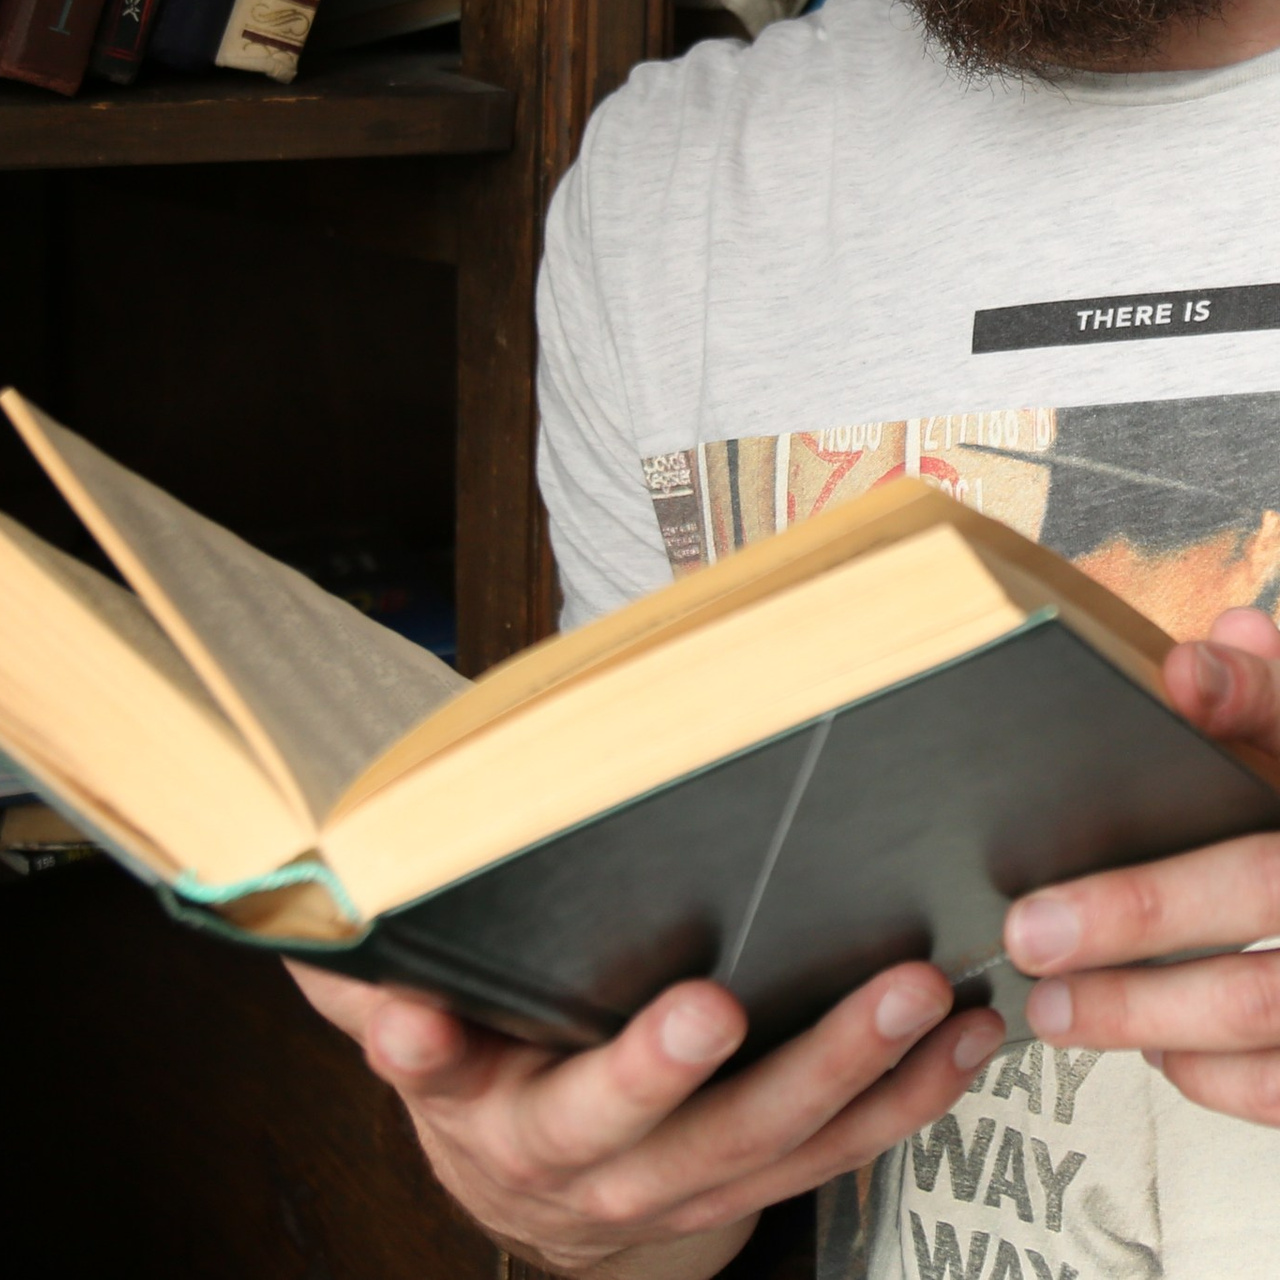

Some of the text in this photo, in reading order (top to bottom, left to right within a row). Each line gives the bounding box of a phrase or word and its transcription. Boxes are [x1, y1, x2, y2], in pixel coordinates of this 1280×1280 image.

[1076, 300, 1212, 331] THERE IS
[967, 1041, 1104, 1125] AY
[910, 1112, 1088, 1233] WAY
